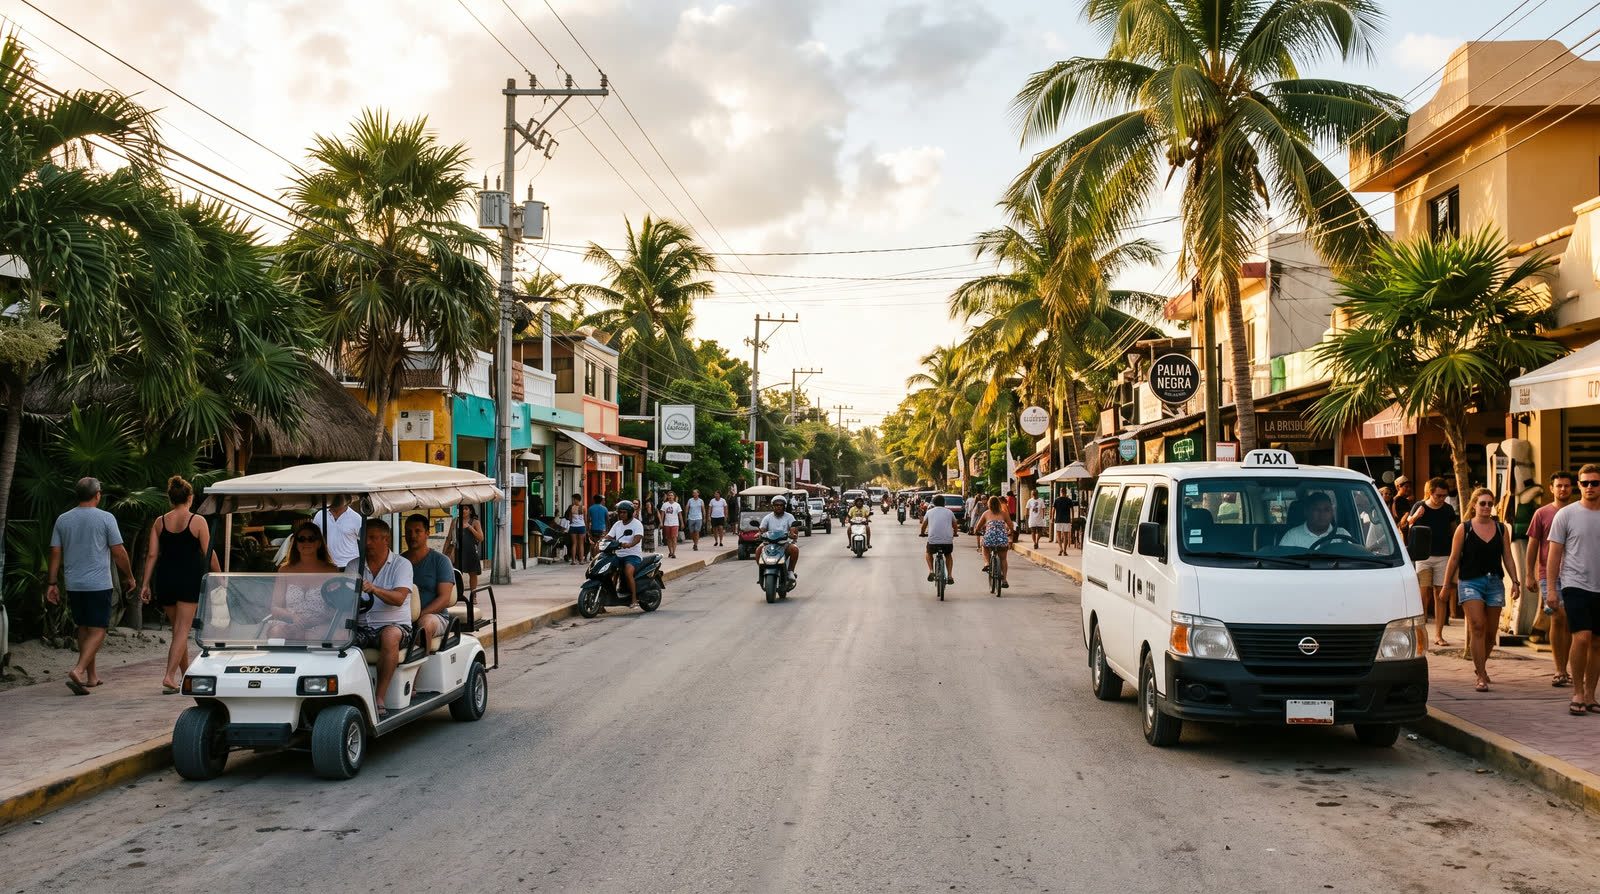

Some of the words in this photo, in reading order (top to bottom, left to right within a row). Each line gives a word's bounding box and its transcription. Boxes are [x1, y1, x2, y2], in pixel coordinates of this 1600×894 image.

[1157, 364, 1192, 376] PALMA
[1157, 377, 1192, 389] NEGRA
[1264, 420, 1275, 432] LA
[1253, 453, 1287, 465] TAXI
